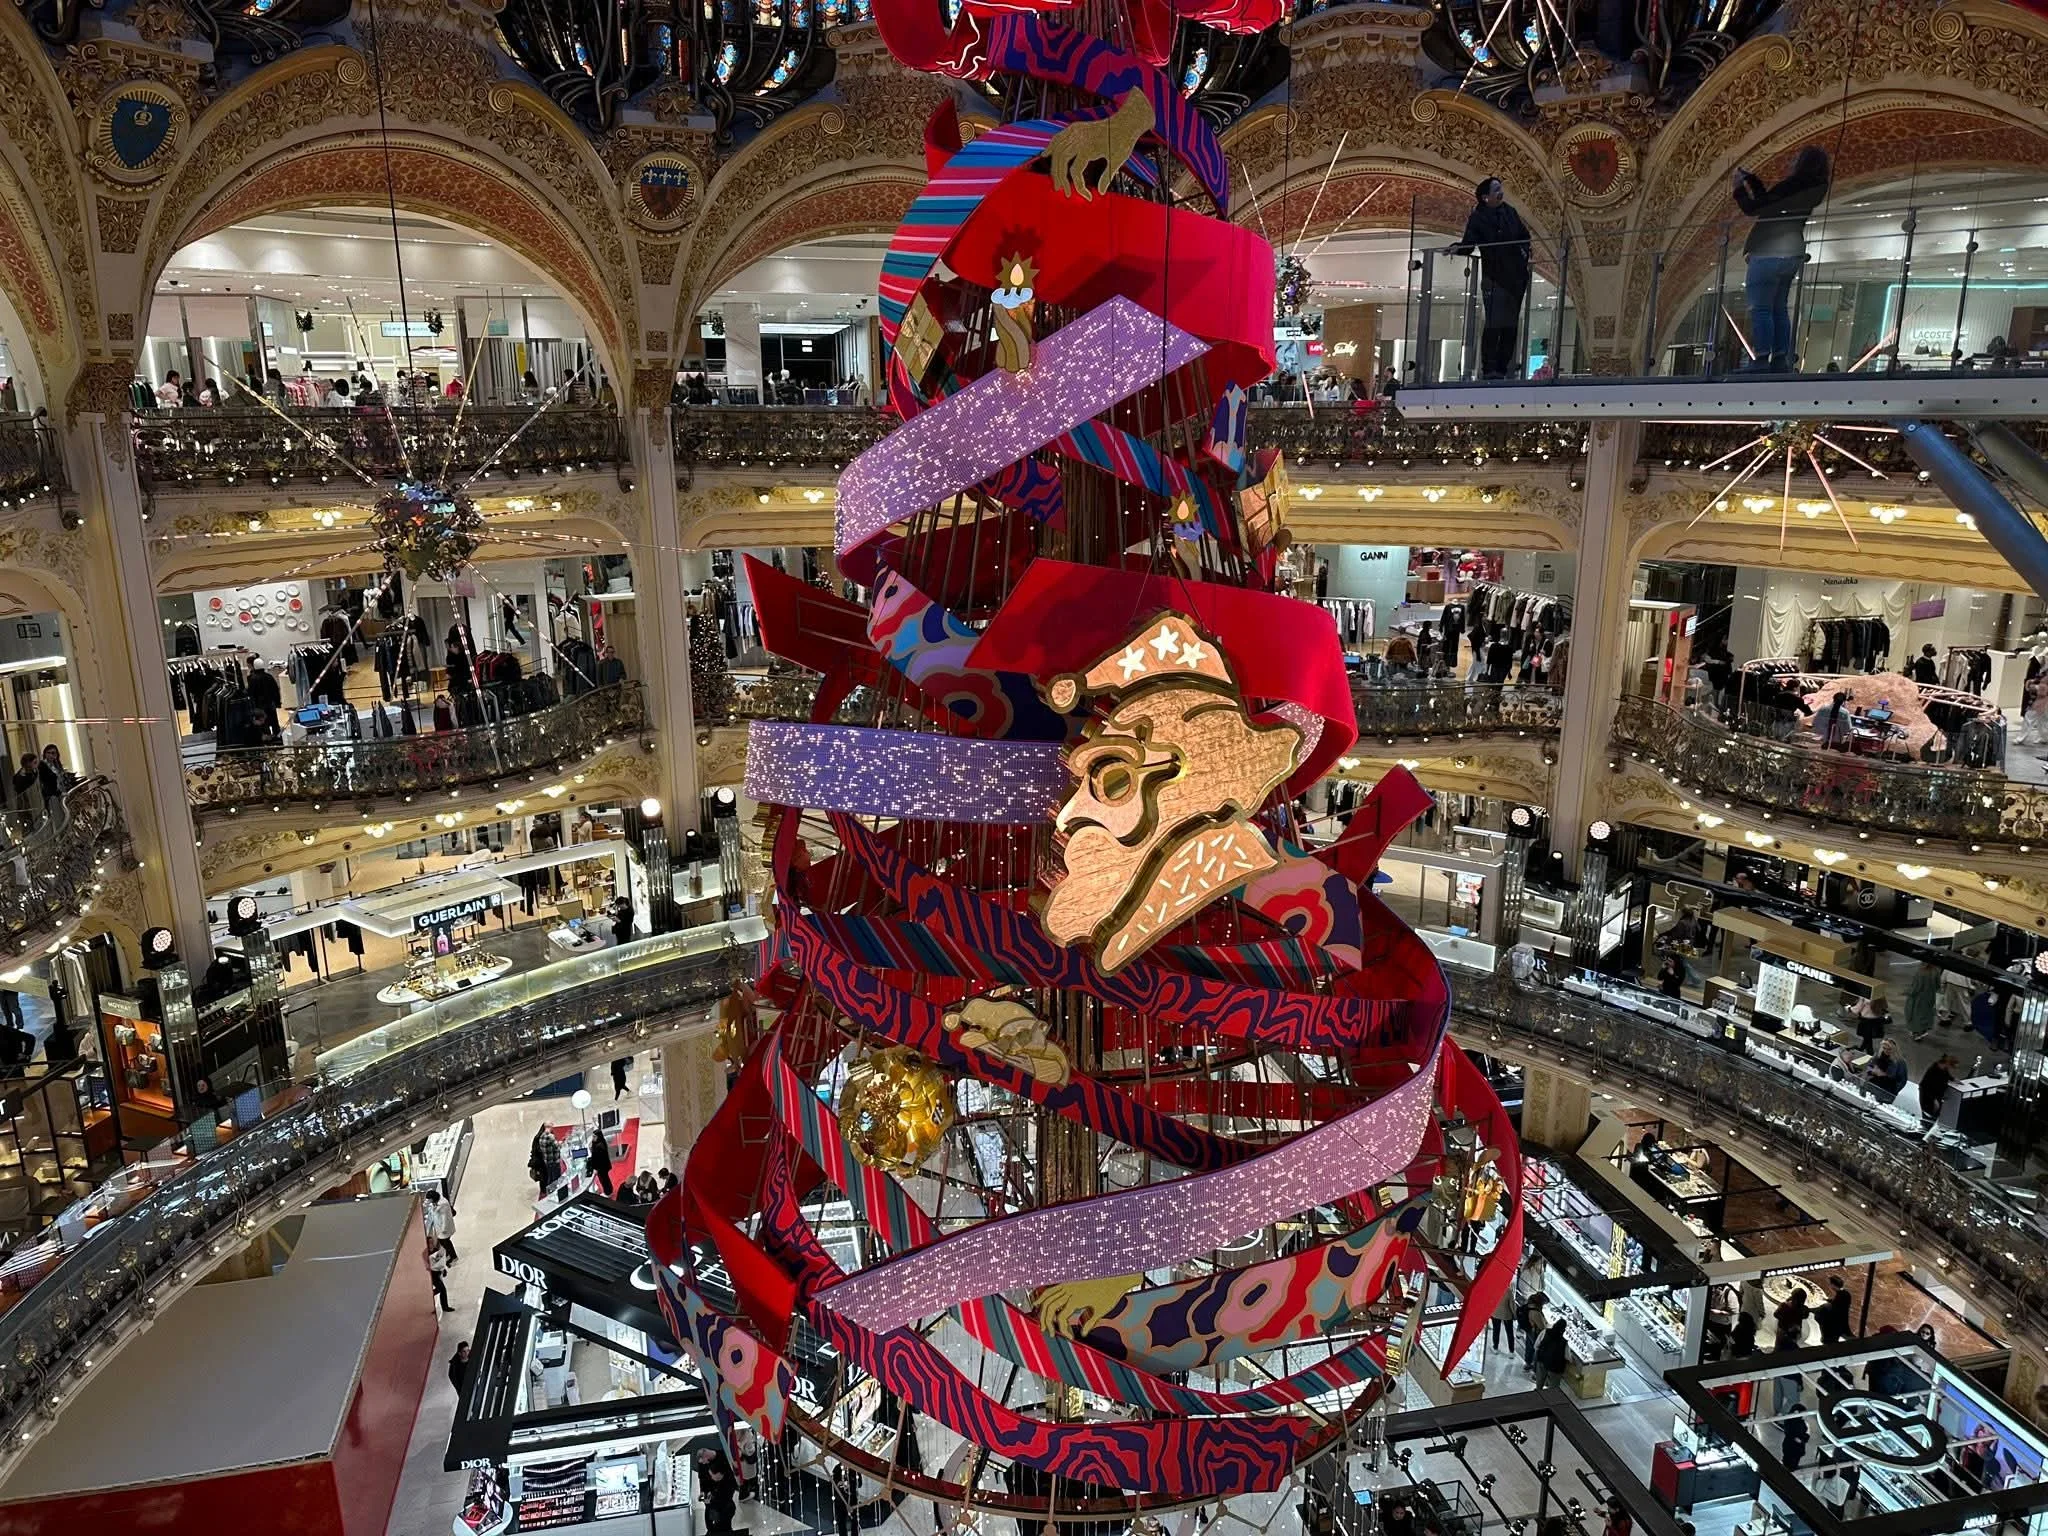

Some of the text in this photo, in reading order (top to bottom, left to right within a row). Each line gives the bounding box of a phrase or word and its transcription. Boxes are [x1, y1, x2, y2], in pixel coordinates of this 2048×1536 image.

[1360, 551, 1388, 561] GANNI
[418, 898, 487, 927] GUERLAIN
[1786, 960, 1835, 985] CHANEL
[500, 1253, 548, 1291] DIOR
[460, 1457, 491, 1470] DIOR
